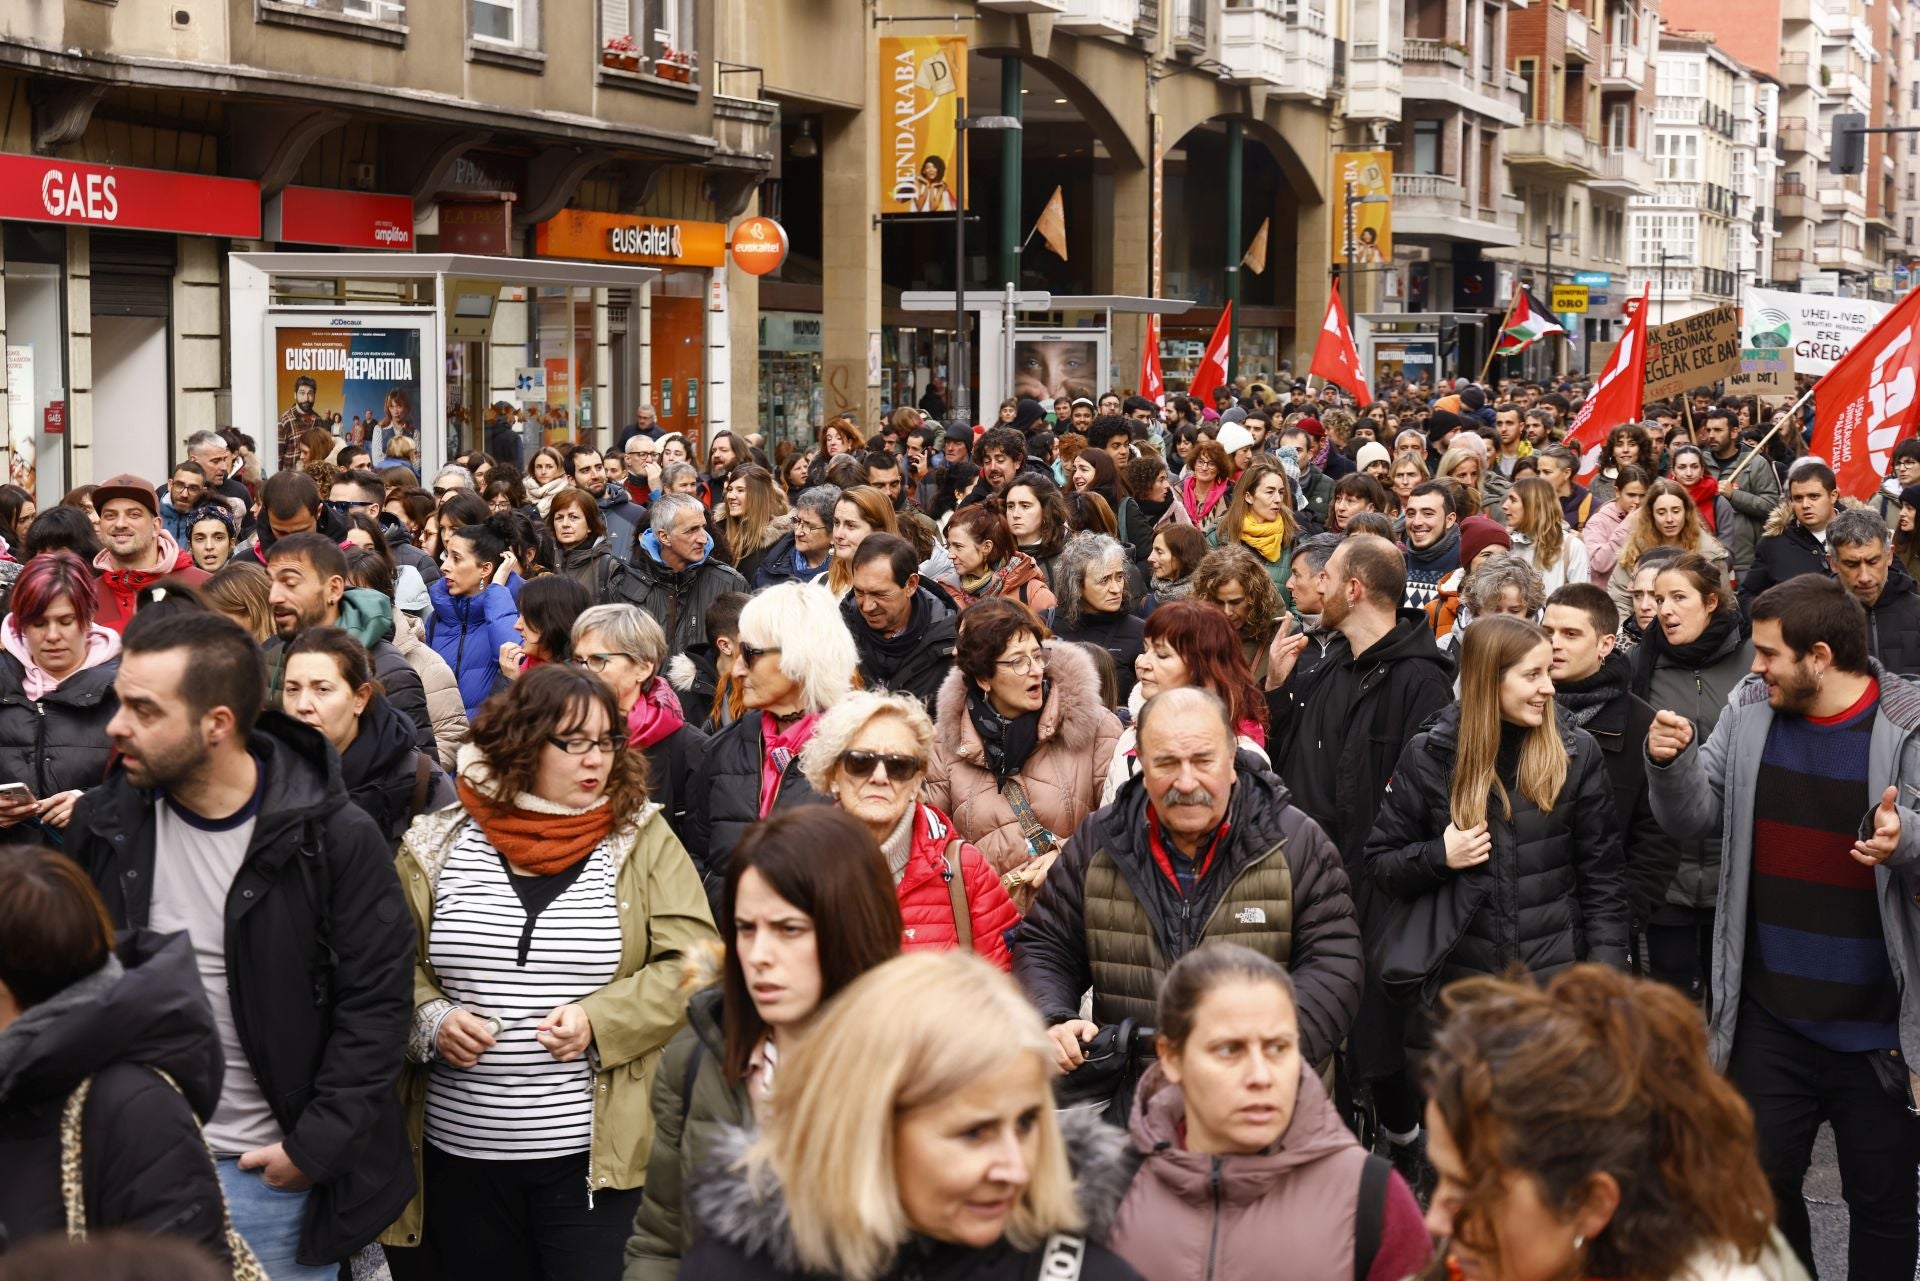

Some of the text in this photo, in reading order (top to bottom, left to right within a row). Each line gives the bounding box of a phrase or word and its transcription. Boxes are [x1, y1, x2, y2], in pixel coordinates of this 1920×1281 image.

[930, 60, 947, 81] D
[893, 49, 919, 200] DENDARABA
[42, 169, 118, 221] GAES
[375, 226, 408, 245] amplifon
[612, 225, 670, 256] euskaltel
[735, 242, 780, 254] euskaltel
[1557, 299, 1584, 308] ORO
[793, 320, 820, 335] MUNDO
[1667, 322, 1683, 337] eta
[1686, 307, 1733, 333] HERRIAK
[1816, 331, 1841, 341] ERE
[285, 348, 347, 371] CUSTODIA
[1693, 346, 1715, 369] ERE
[344, 358, 412, 381] REPARTIDA
[1731, 373, 1750, 385] NAHI
[47, 413, 62, 423] GAES
[1841, 402, 1856, 463] SINDIKALISMO
